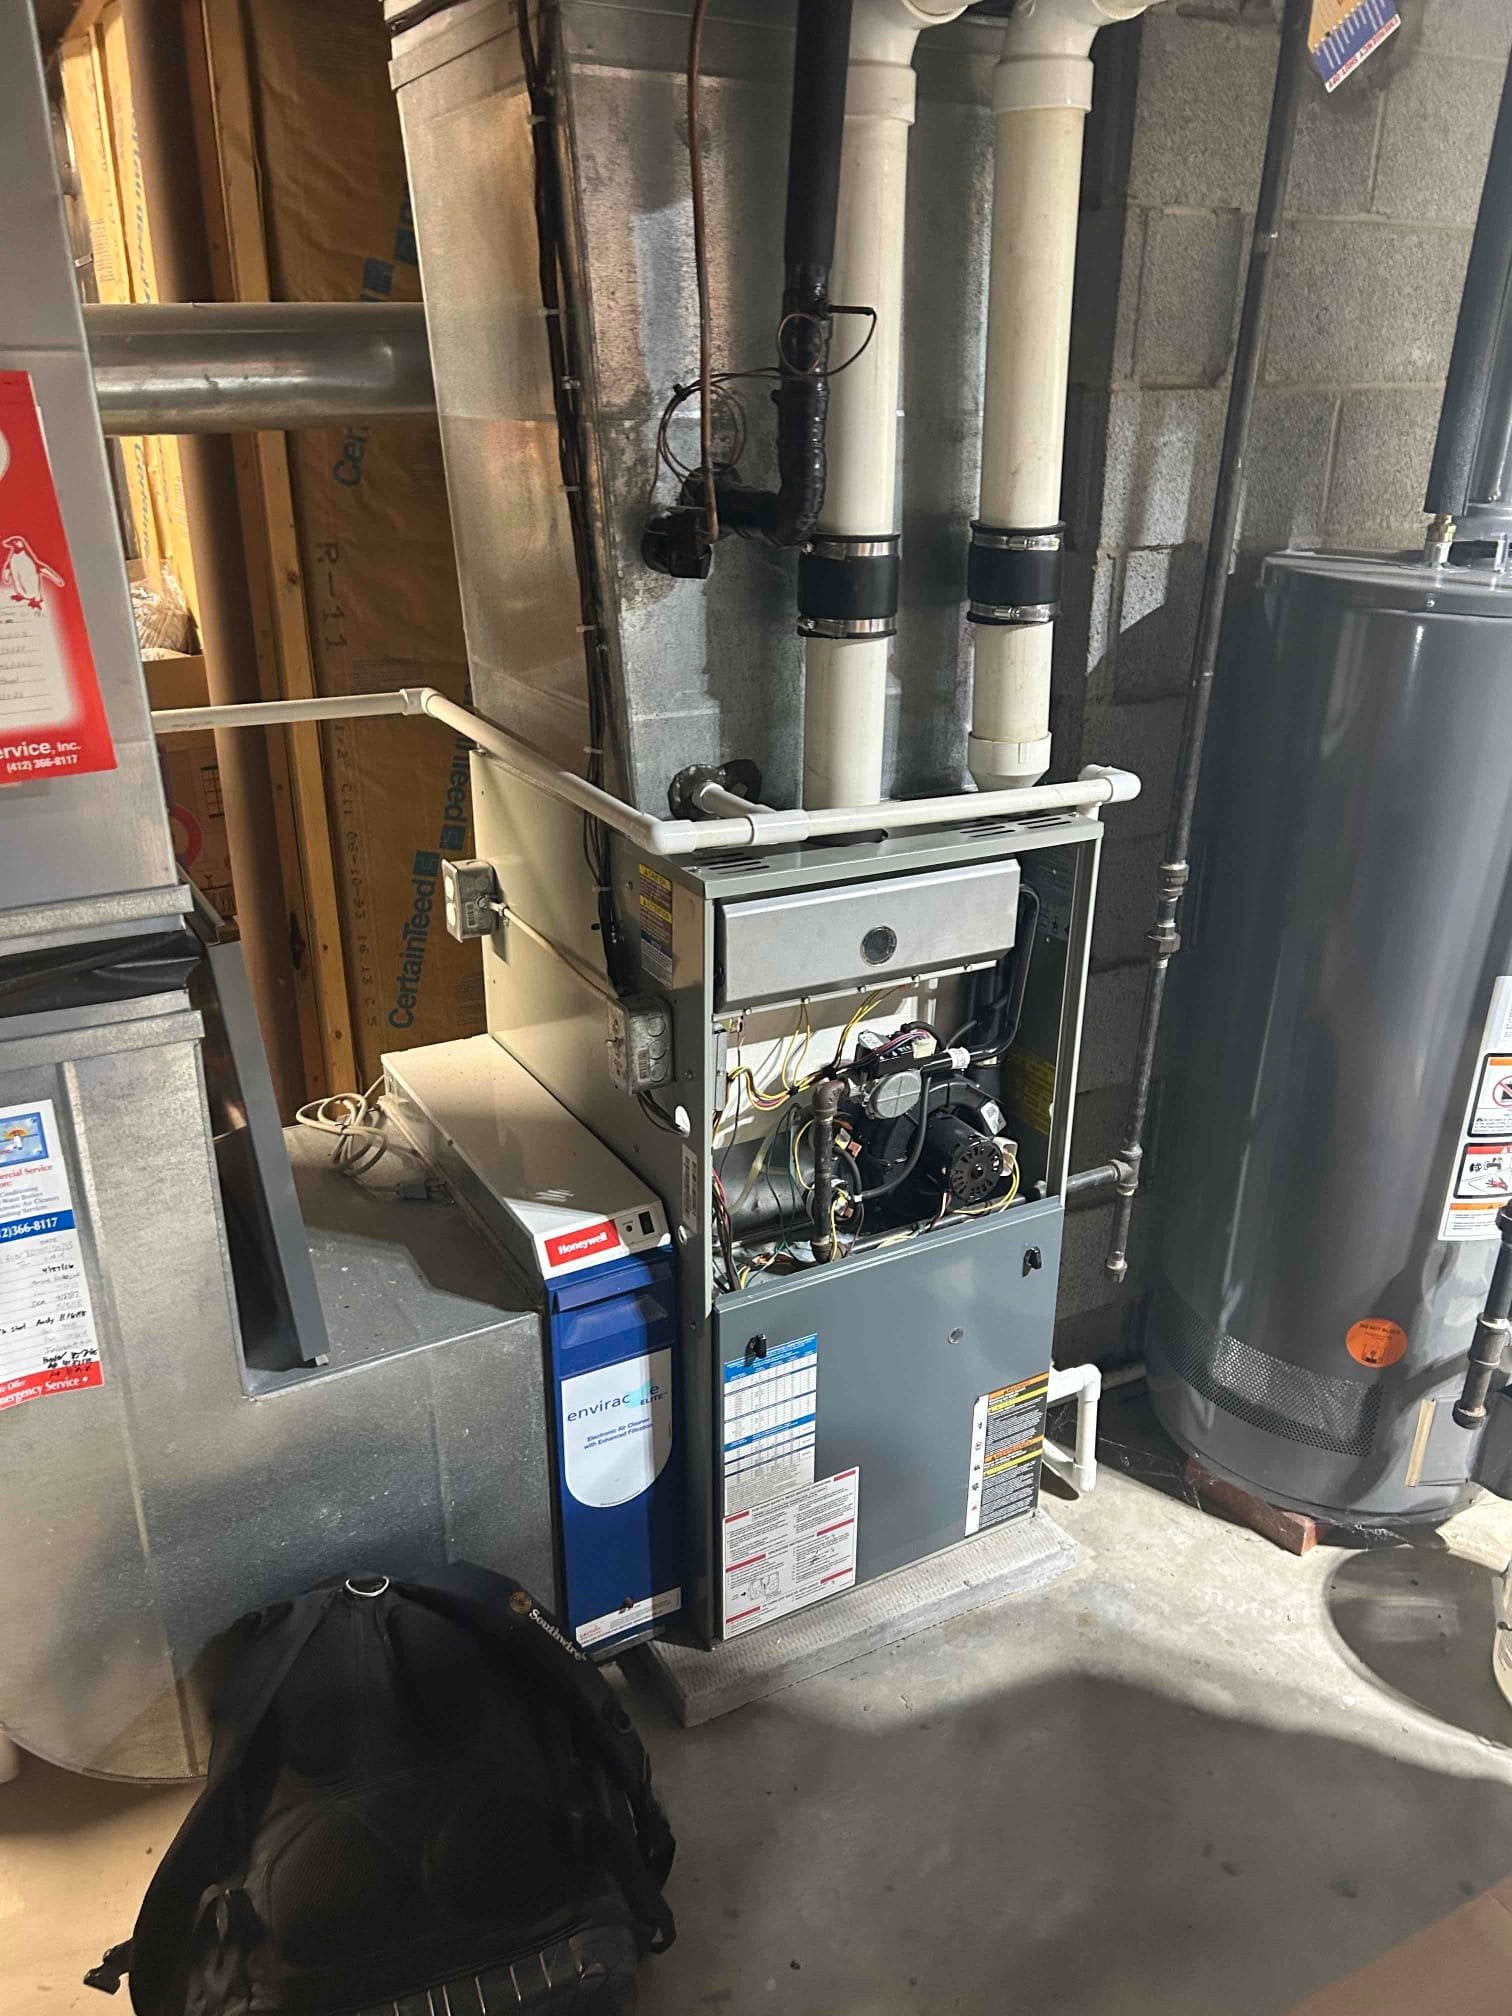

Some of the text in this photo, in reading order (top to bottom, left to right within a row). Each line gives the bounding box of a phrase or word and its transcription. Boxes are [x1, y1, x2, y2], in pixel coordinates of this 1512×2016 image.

[315, 542, 348, 652] R-11
[388, 877, 438, 1030] CertainTeed
[0, 1216, 58, 1239] 2)366-8117
[557, 1231, 608, 1255] Honeywell
[44, 1376, 80, 1392] Service
